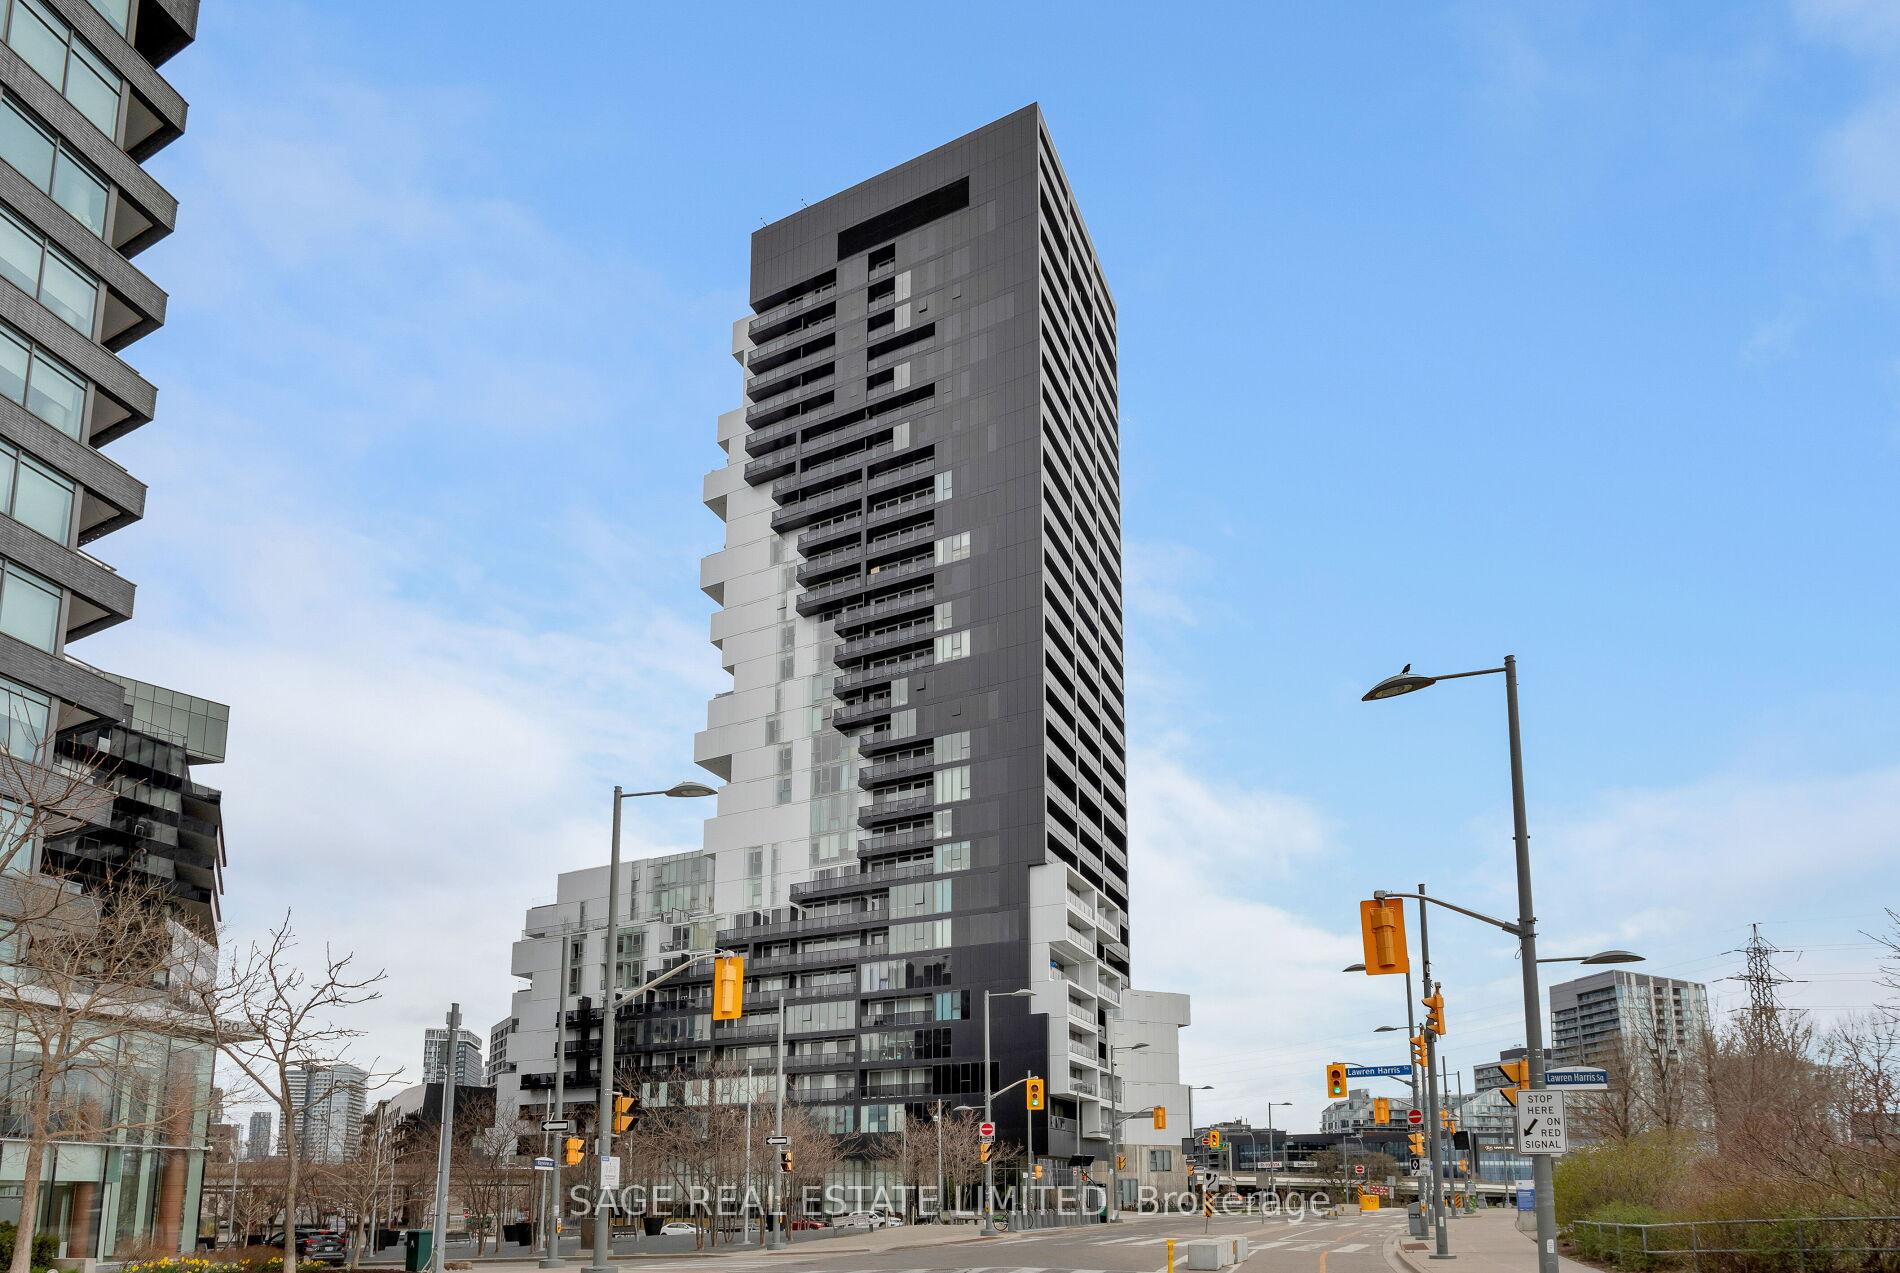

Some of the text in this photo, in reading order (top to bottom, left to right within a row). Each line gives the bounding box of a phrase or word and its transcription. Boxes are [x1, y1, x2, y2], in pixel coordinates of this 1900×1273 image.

[218, 1020, 240, 1032] 120
[1347, 1068, 1375, 1076] Lawren
[1377, 1067, 1401, 1075] Harris
[1547, 1073, 1604, 1083] Lawren Harris Sq
[1527, 1095, 1553, 1104] STOP
[1527, 1106, 1554, 1115] HERE
[1546, 1117, 1561, 1126] ON
[1541, 1129, 1561, 1137] RED
[1525, 1140, 1562, 1149] SIGNAL
